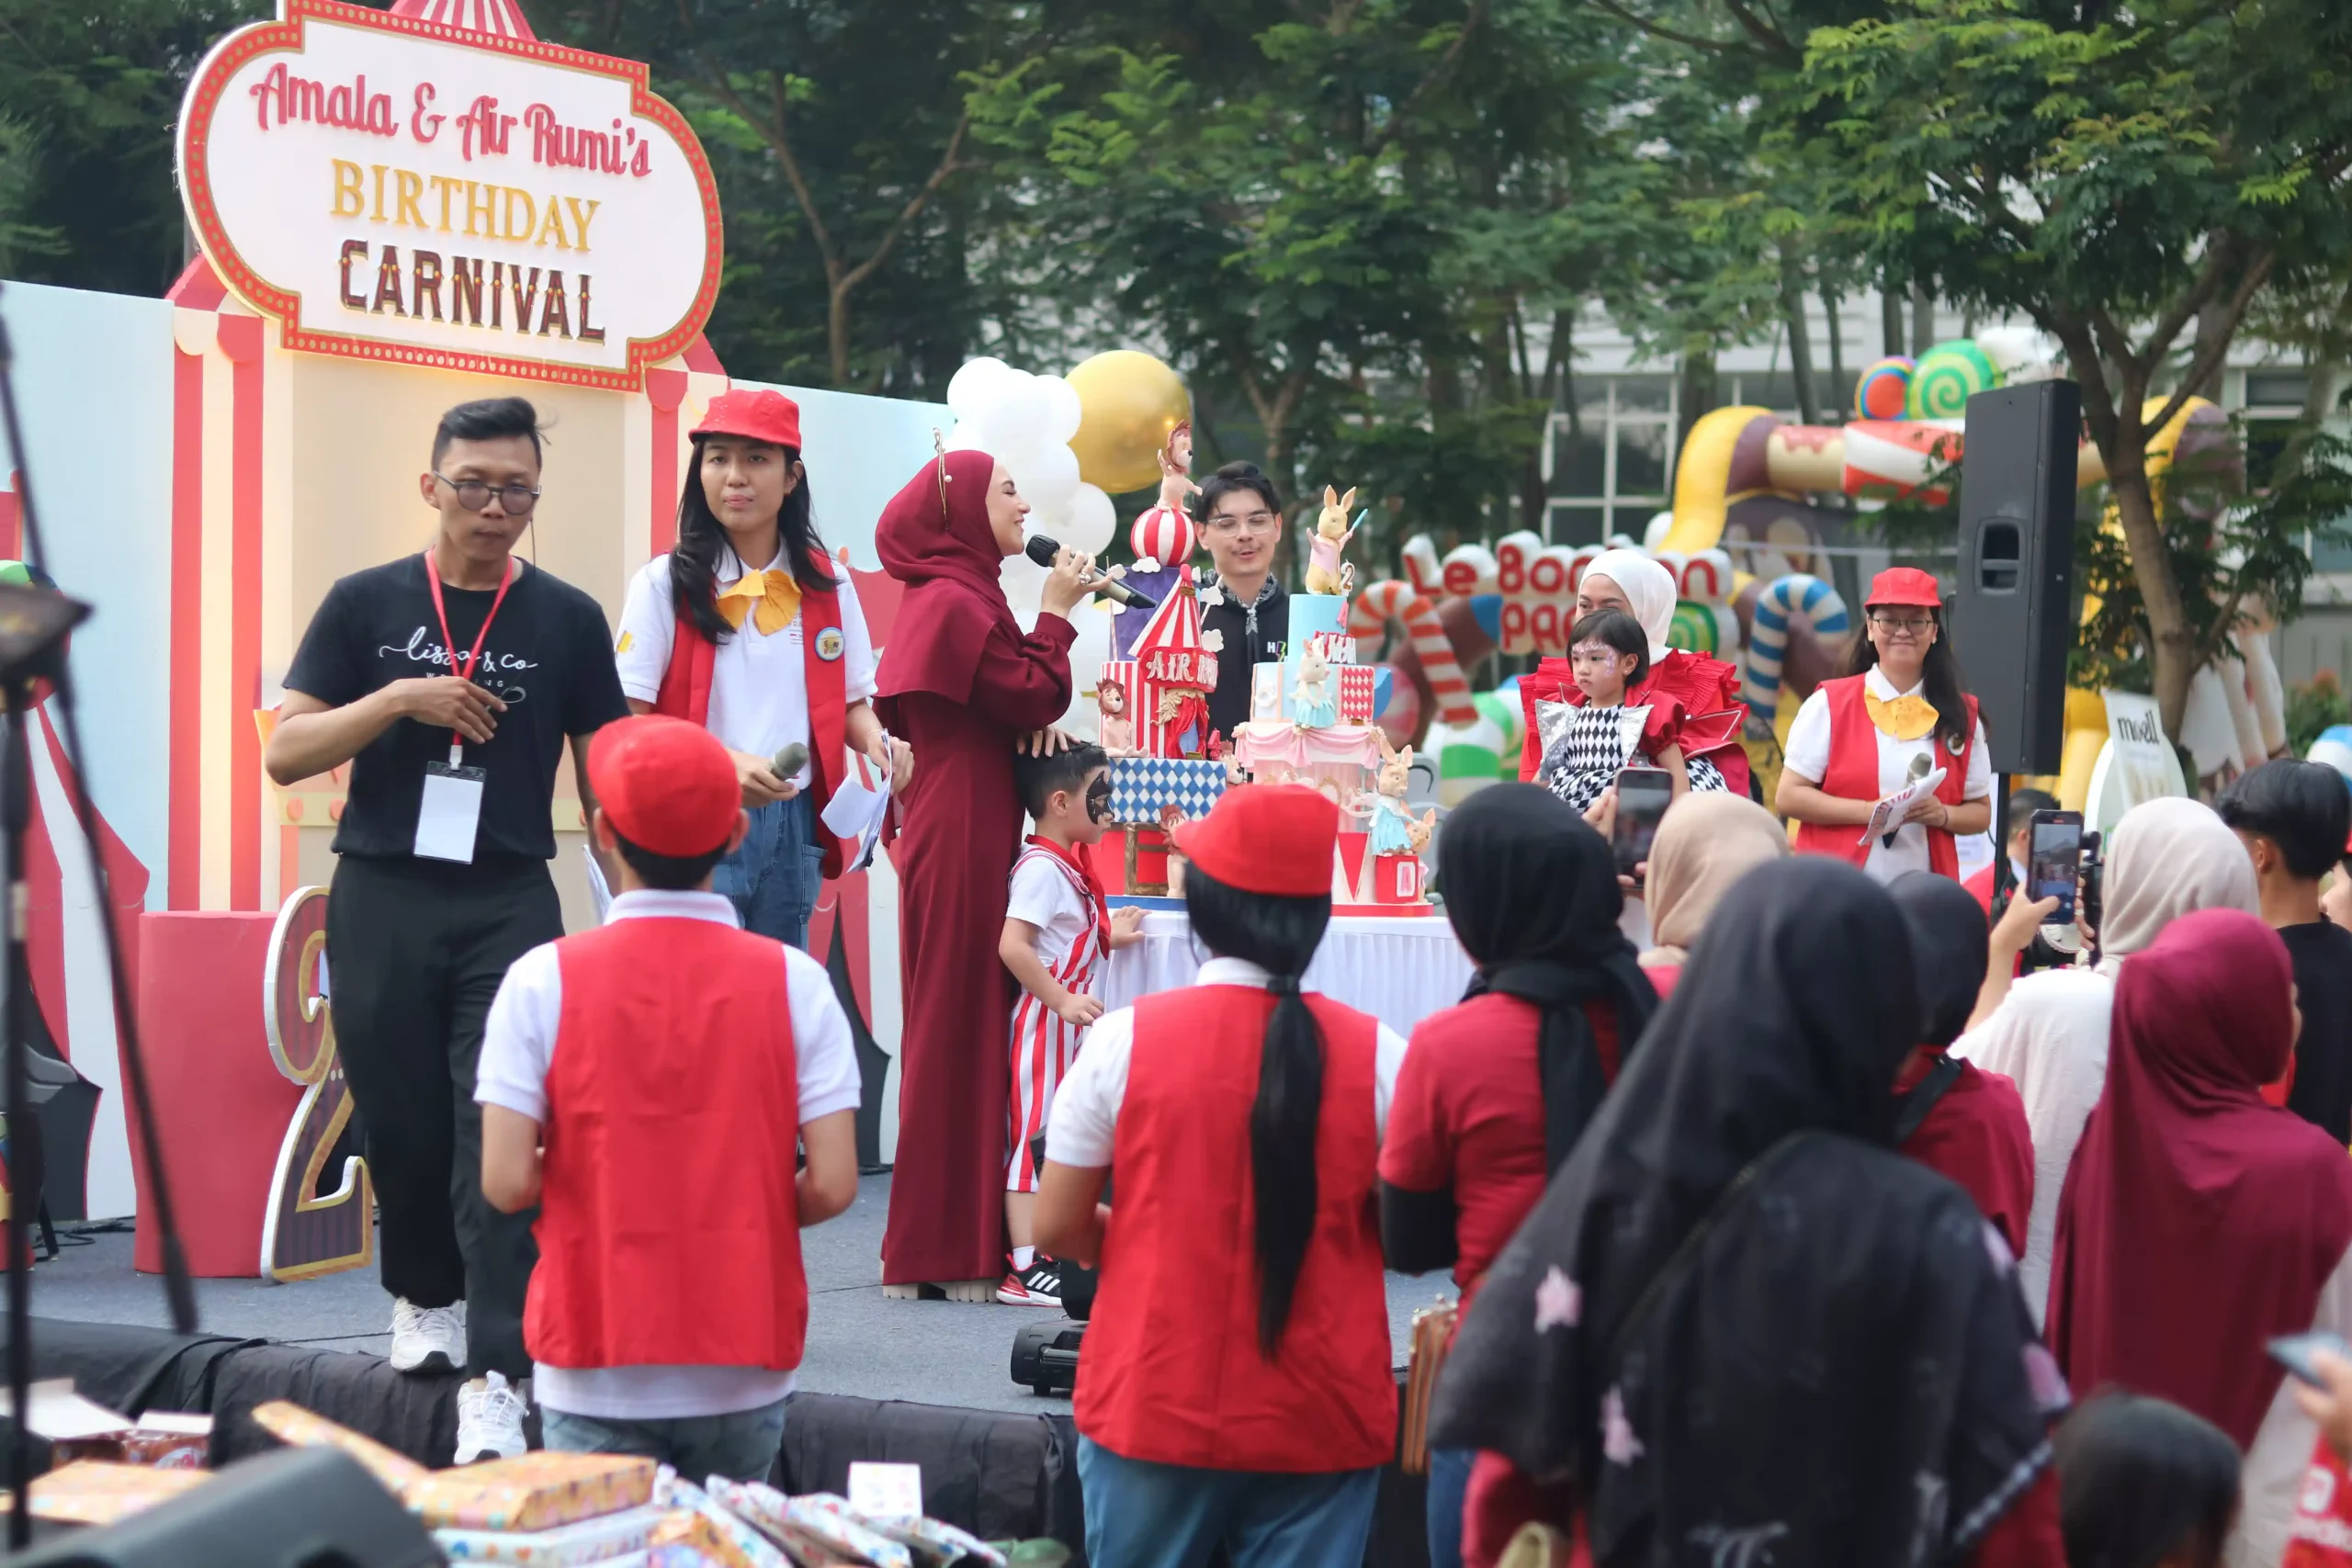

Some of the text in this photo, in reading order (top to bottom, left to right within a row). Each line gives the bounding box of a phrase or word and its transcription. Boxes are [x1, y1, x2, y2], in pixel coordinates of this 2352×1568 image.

[250, 62, 651, 177] Amala & Air Rumi's
[330, 158, 600, 252] BIRTHDAY
[338, 238, 605, 345] CARNIVAL
[1403, 553, 1478, 595] Le
[426, 671, 503, 688] WING
[1146, 651, 1194, 682] AIR
